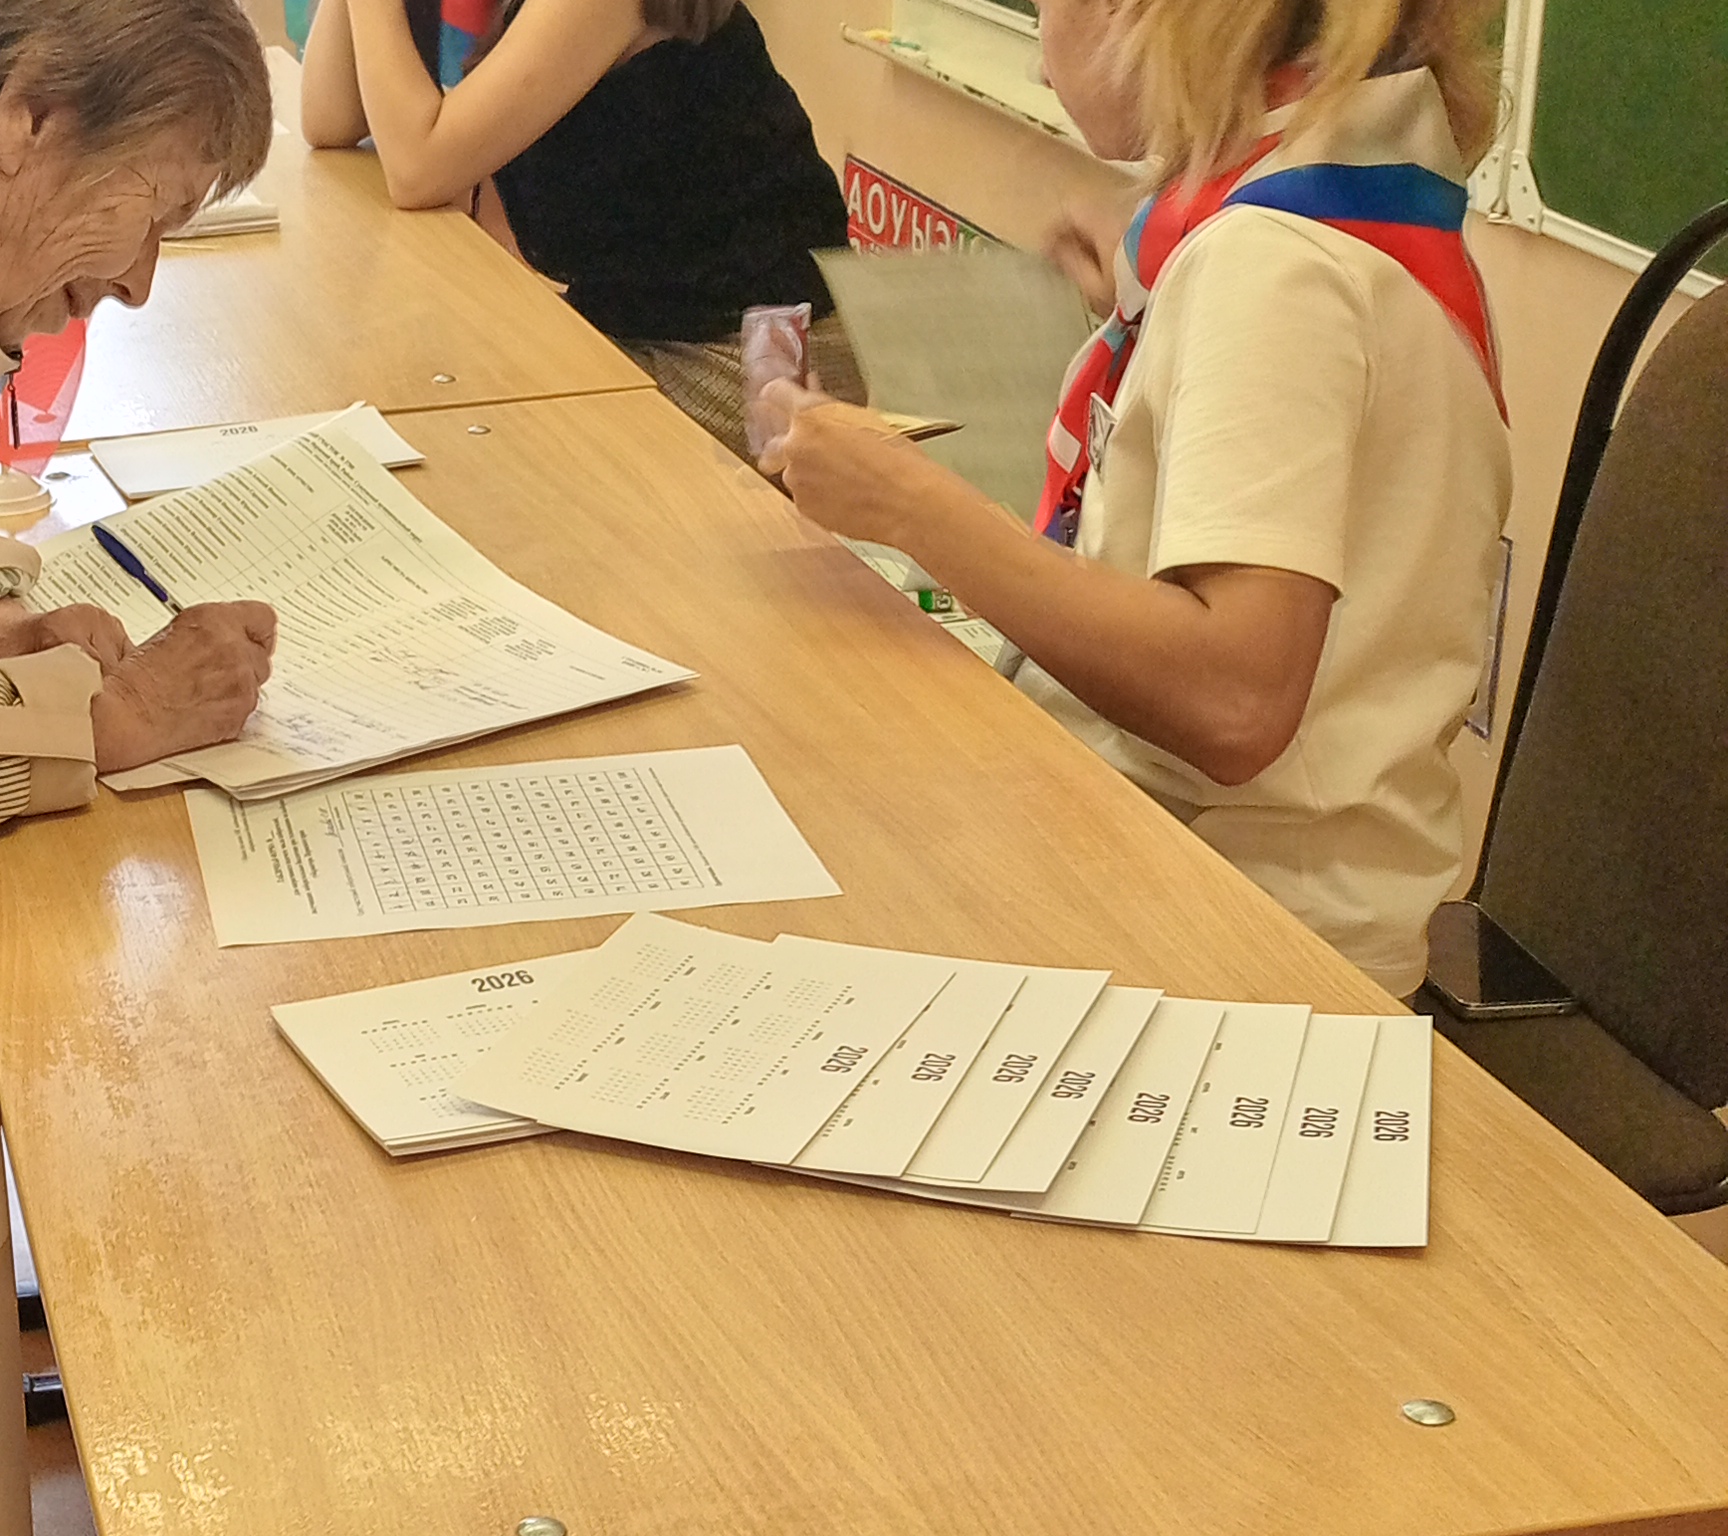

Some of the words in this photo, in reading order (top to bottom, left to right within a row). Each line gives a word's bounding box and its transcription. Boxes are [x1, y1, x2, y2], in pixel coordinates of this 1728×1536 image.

[471, 969, 535, 993] 2026
[820, 1045, 869, 1074] 2026
[910, 1052, 956, 1083] 2026
[991, 1053, 1038, 1084] 2026
[1050, 1070, 1096, 1100] 2026
[1127, 1092, 1171, 1124] 2026
[1229, 1096, 1270, 1129] 2026
[1298, 1107, 1340, 1139] 2026
[1373, 1110, 1410, 1142] 2026
